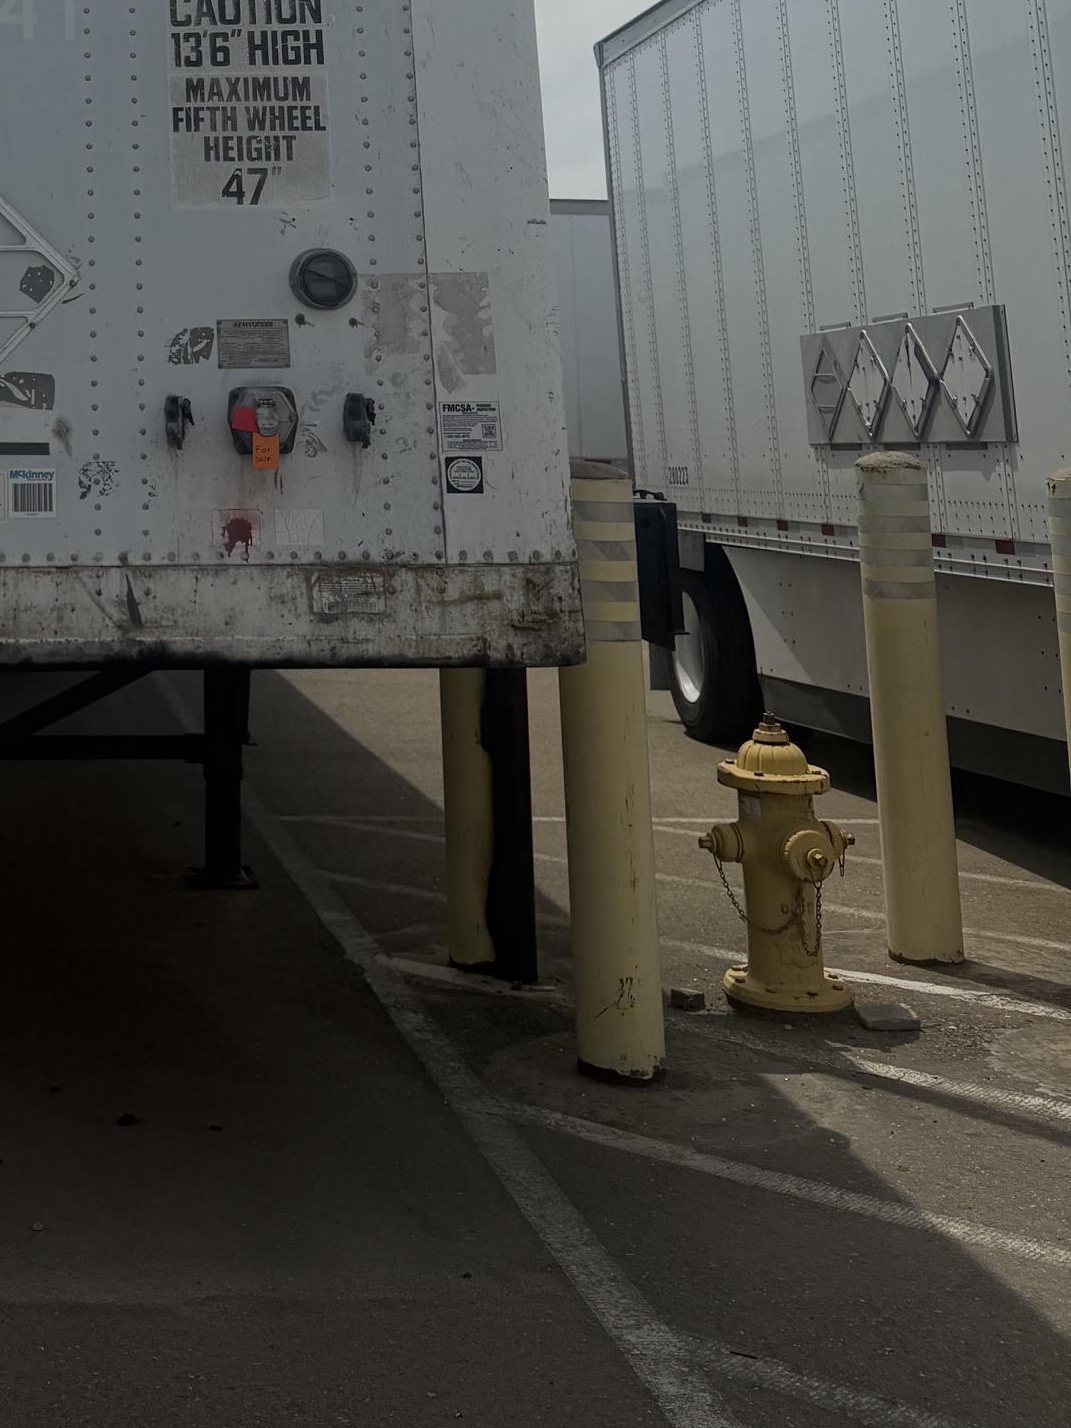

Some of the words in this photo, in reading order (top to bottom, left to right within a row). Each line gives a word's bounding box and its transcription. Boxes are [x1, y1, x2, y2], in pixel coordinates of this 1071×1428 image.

[247, 29, 324, 66] HIGH
[185, 76, 311, 103] MAXIMUM
[172, 106, 238, 133] FIFTH
[245, 105, 326, 132] WHEEL
[203, 135, 297, 162] HEIGHT
